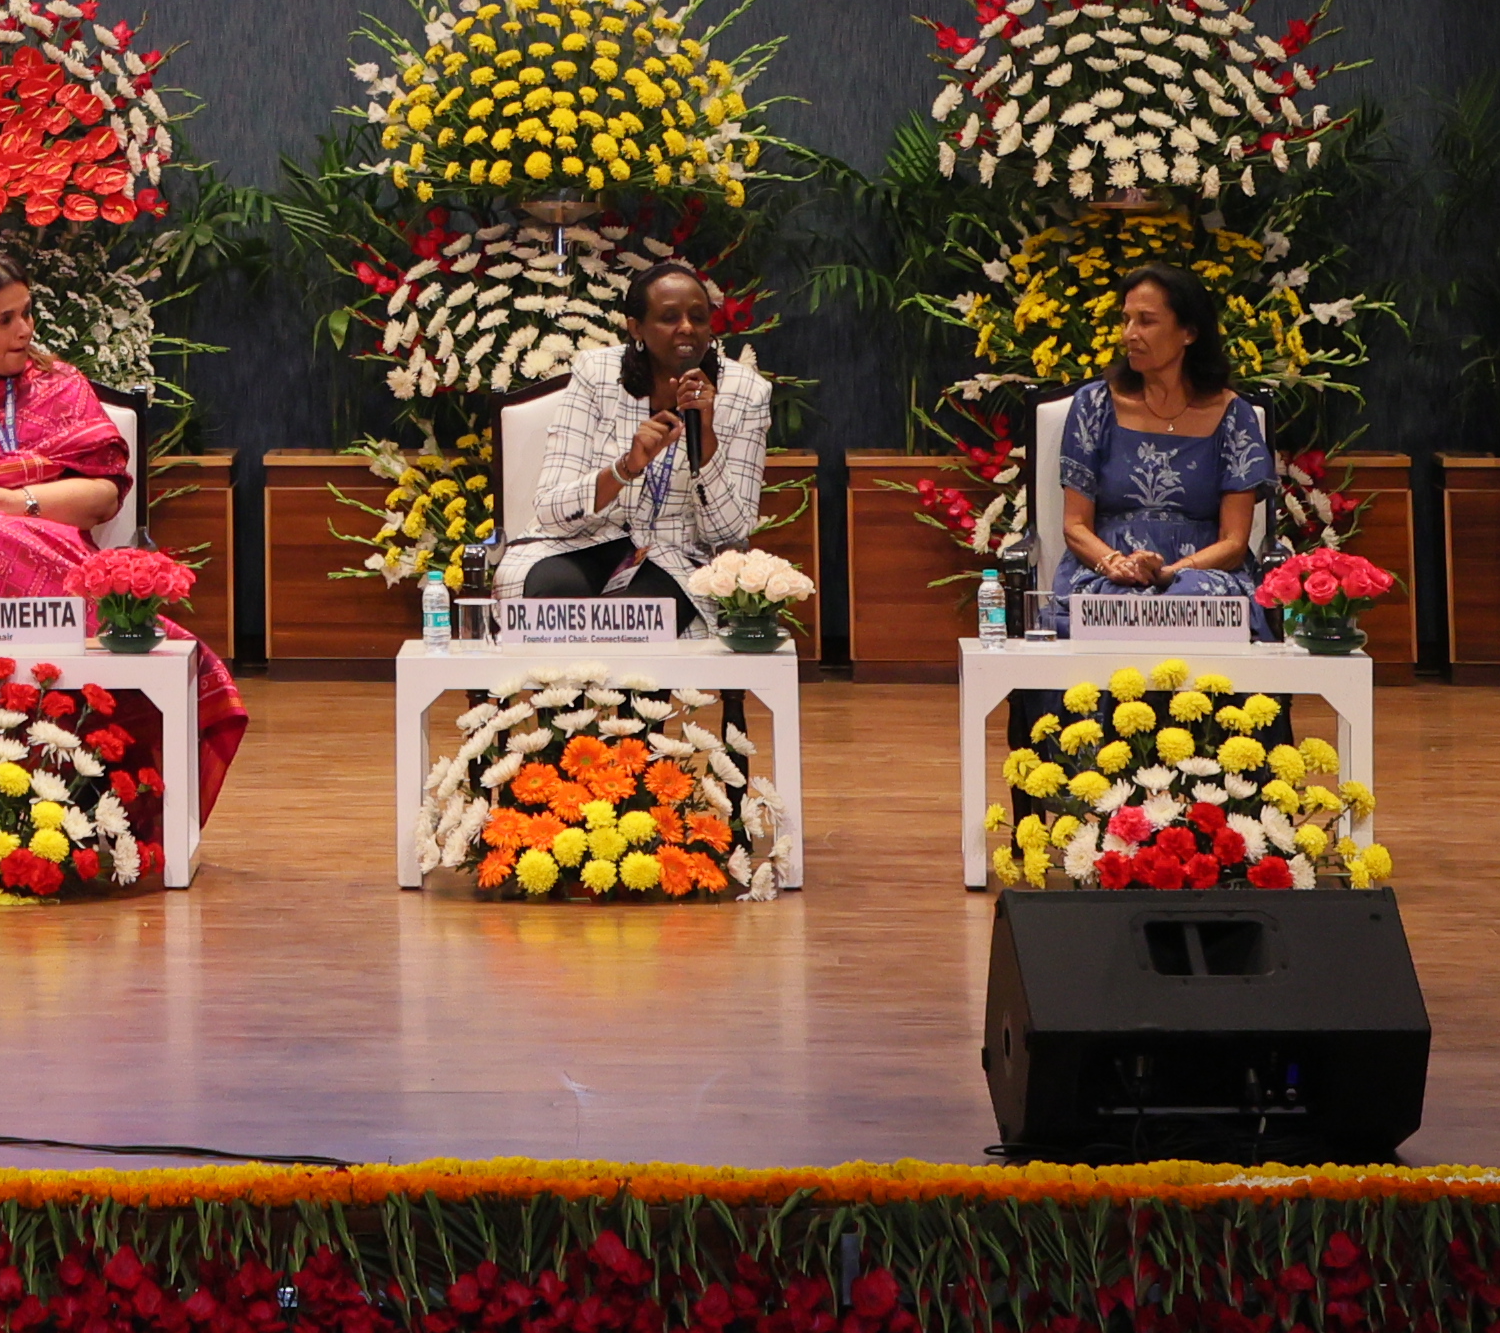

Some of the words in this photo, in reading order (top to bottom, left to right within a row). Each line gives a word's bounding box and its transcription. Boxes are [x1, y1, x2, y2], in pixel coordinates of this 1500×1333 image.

[0, 601, 76, 629] MEHTA
[507, 605, 531, 630] DR.
[536, 604, 586, 630] AGNES
[592, 604, 664, 630] KALIBATA
[1082, 600, 1139, 626] SHAKUNTALA
[1142, 600, 1198, 627] HARAKSINGH
[1201, 601, 1242, 627] THILSTED
[523, 635, 551, 643] Founder
[553, 635, 566, 643] and
